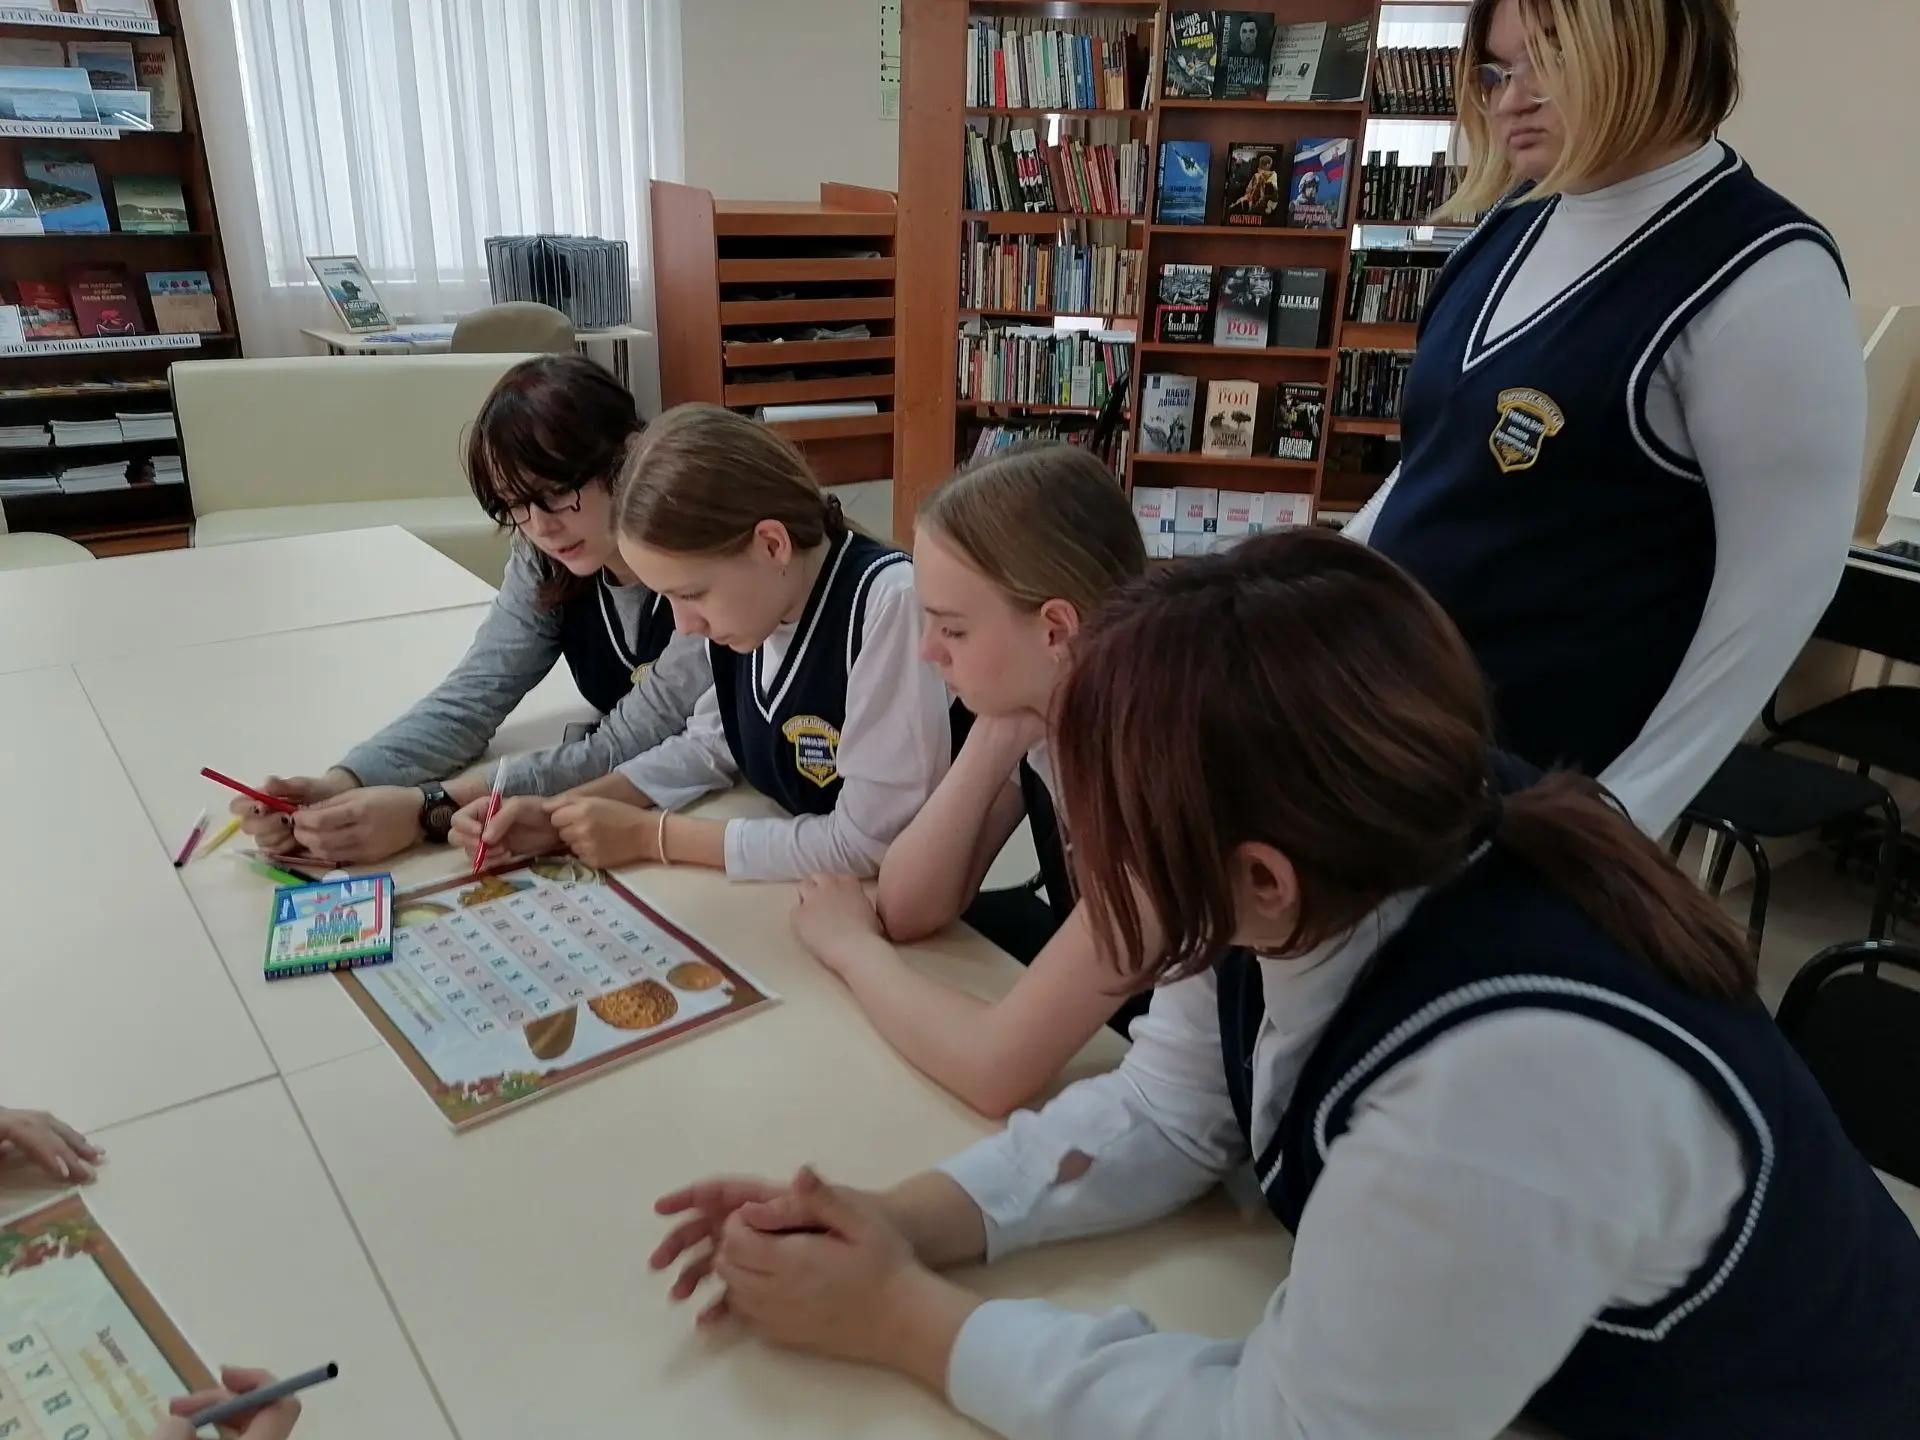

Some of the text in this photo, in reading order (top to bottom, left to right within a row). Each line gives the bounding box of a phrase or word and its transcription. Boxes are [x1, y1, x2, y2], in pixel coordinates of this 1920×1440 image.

[38, 12, 66, 24] МОЙ
[69, 14, 100, 27] КРАЙ
[69, 126, 113, 136] БЫЛОМ
[1226, 320, 1260, 336] РОЙ
[4, 342, 40, 354] ЛЮДИ
[96, 338, 139, 348] ИМЕНА
[151, 336, 195, 346] СУДЬБЫ
[1218, 390, 1250, 406] РОЙ
[7, 1334, 90, 1440] Б У Н О
